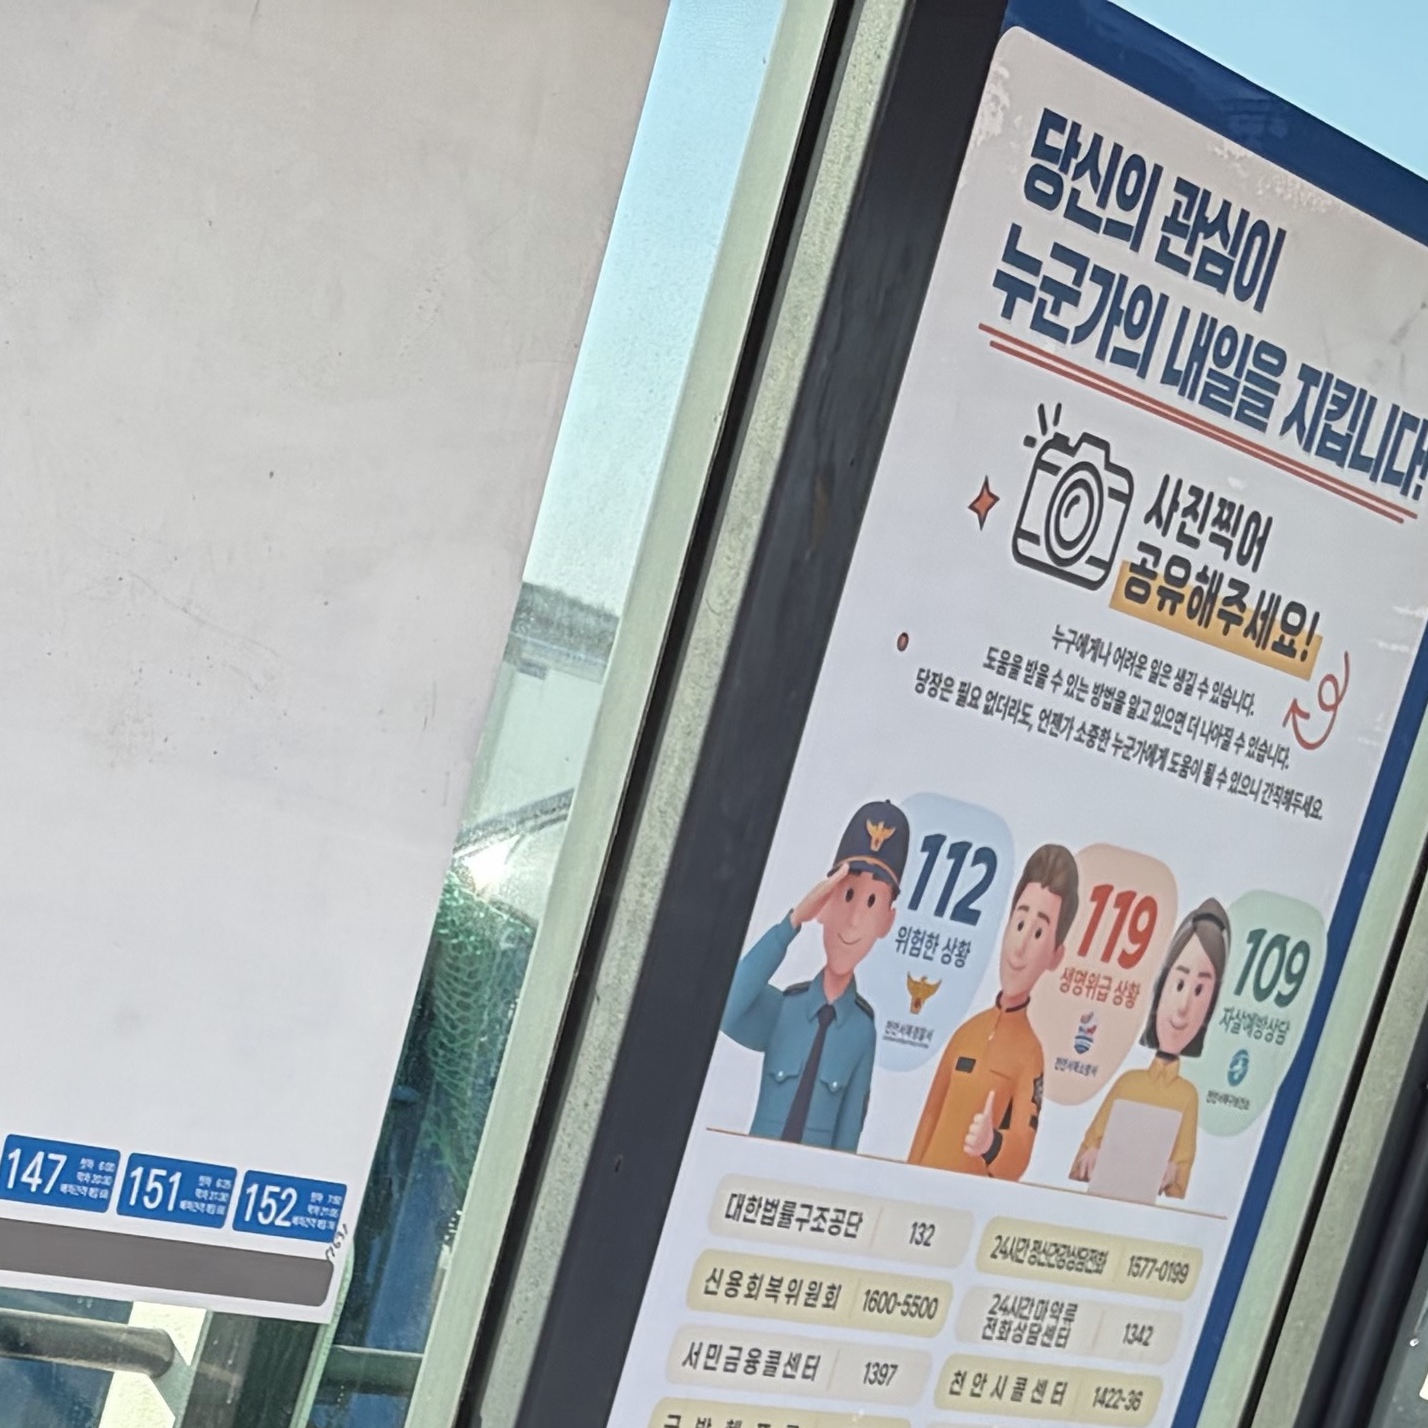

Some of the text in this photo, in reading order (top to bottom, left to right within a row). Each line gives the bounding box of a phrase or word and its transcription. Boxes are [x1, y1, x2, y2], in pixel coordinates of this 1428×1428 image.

[1023, 108, 1287, 312] 당신의 관심이
[993, 224, 1428, 501] 누군가의 내일을 지킵니다!
[1145, 474, 1273, 573] 사진찍어
[1124, 541, 1321, 662] 공유해주세요!
[1052, 624, 1255, 716] 누구에게나 어려운 일은 생길 수 있습니다.
[983, 646, 1290, 770] 도움을 받을 수 있는 방법을 알고 있으면 더 나아질 수 있습니다.
[915, 668, 955, 702] 당장은
[955, 682, 981, 710] 필요
[1037, 708, 1075, 742] 언젠가
[1077, 721, 1111, 752] 소중한
[1112, 732, 1169, 772] 누군가에게
[1167, 752, 1203, 783] 도움이
[1215, 767, 1228, 790] 수
[1228, 771, 1262, 802] 있으니
[907, 834, 997, 926] 112
[895, 926, 971, 968] 위험한 상황
[1077, 884, 1157, 970] 119
[1060, 966, 1141, 1010] 생명위급 상황
[1234, 928, 1309, 1008] 109
[1219, 1006, 1289, 1045] 자살예방상담
[8, 1148, 71, 1193] 147
[130, 1167, 181, 1211] 151
[245, 1184, 300, 1226] 152
[725, 1193, 935, 1247] 대한법률구조공단 132
[1127, 1255, 1189, 1284] 1577-0199
[863, 1289, 939, 1320] 1600-5500
[1123, 1323, 1154, 1346] 1342
[863, 1361, 898, 1386] 1397
[1093, 1386, 1143, 1411] 1422-36
